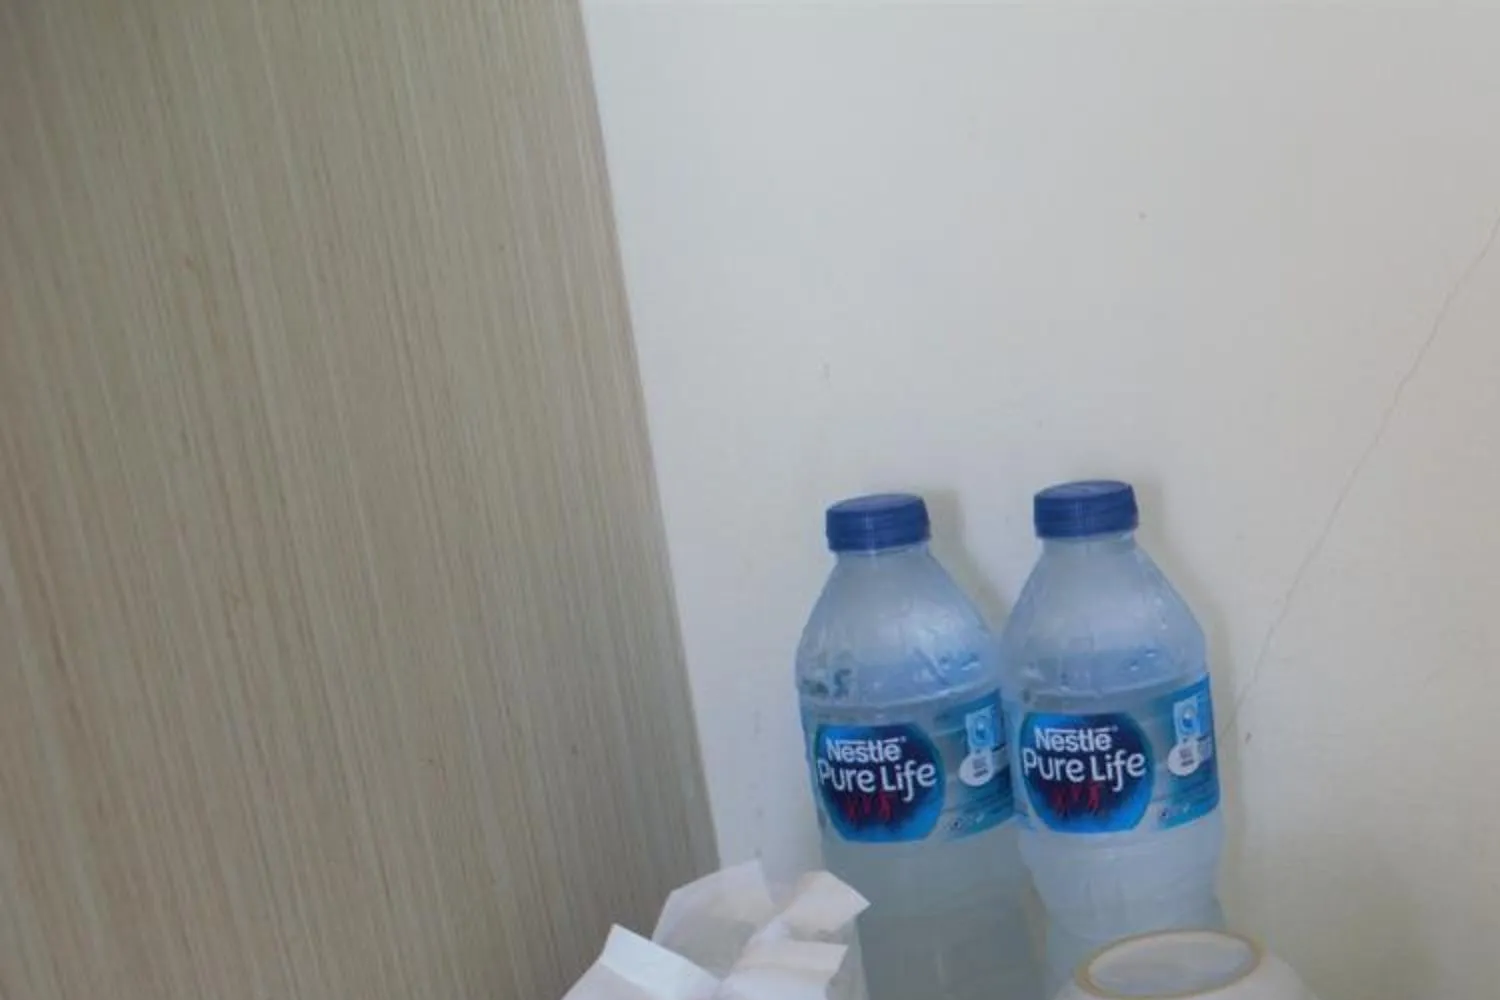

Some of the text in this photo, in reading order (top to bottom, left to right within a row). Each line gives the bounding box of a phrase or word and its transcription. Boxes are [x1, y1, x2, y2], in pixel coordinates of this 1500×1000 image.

[817, 757, 877, 793] Pure
[880, 759, 937, 802] Life
[1022, 747, 1086, 783] Pure
[1089, 749, 1147, 793] Life
